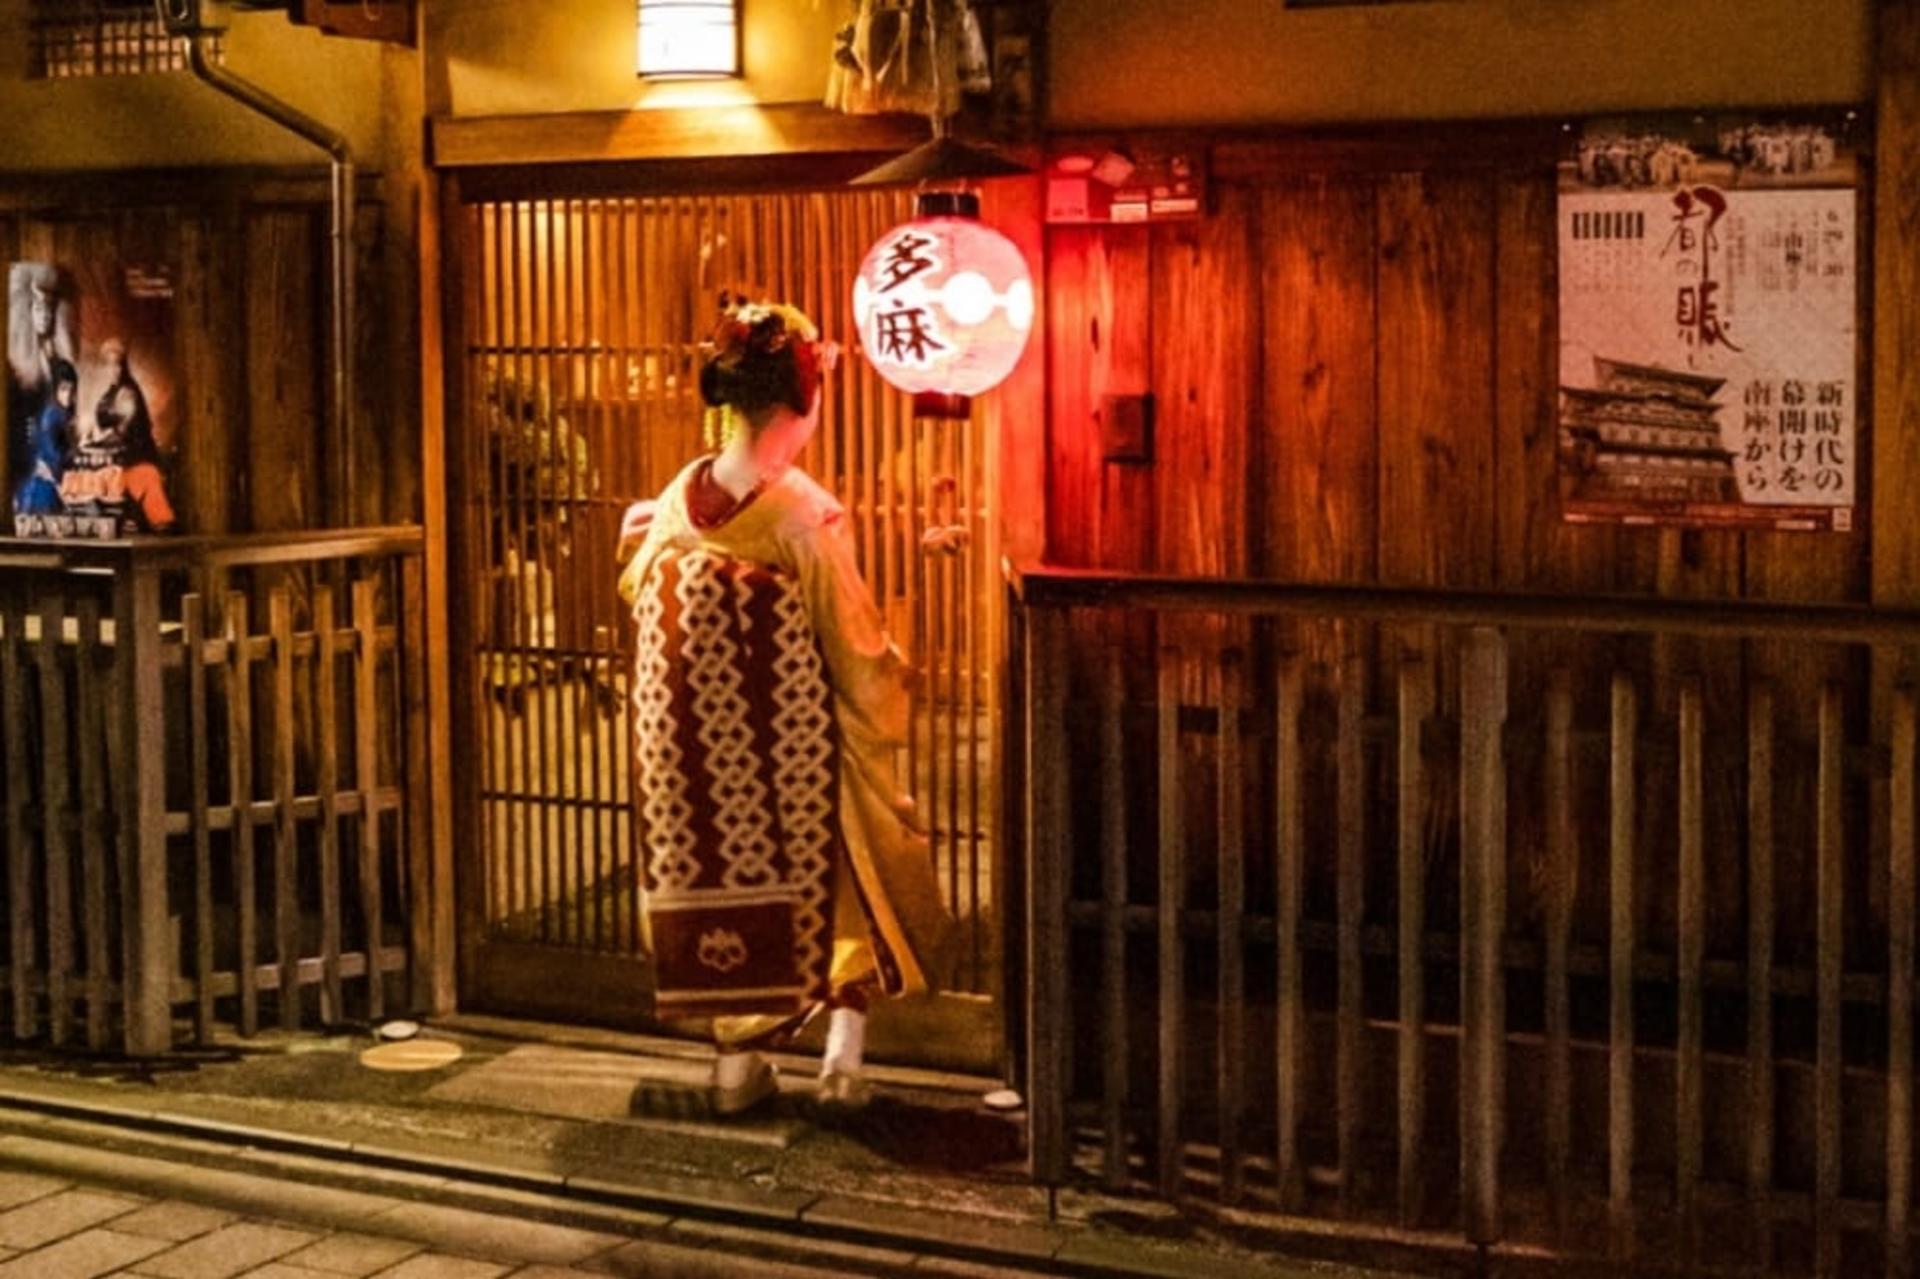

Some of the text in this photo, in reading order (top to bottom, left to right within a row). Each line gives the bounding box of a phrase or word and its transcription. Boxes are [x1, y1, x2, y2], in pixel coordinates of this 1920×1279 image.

[877, 234, 945, 361] 多麻
[1744, 380, 1771, 491] 南座から
[1779, 380, 1805, 492] 幕開けを
[1815, 380, 1844, 491] 新時代の
